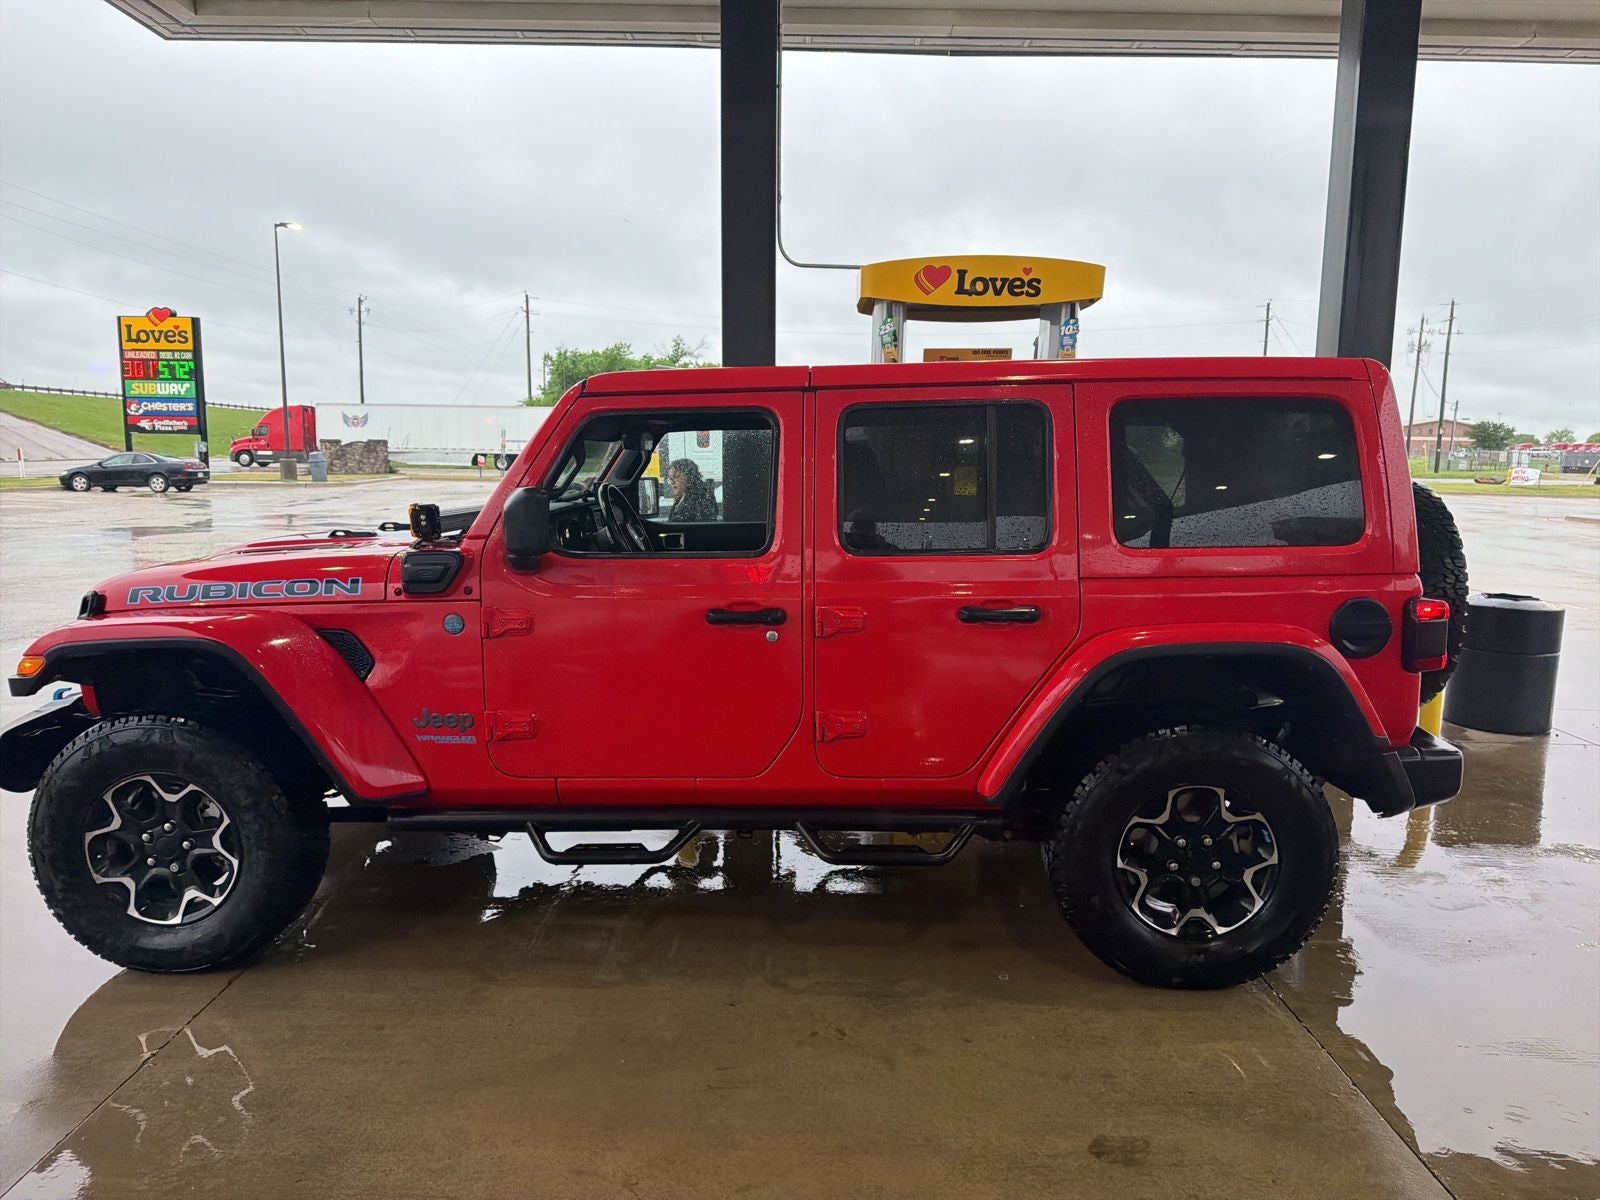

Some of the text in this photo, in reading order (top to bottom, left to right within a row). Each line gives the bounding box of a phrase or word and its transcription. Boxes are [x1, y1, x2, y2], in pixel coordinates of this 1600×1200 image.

[130, 382, 190, 395] SUBWAY
[127, 576, 363, 605] RUBICON
[412, 708, 475, 732] Jeep
